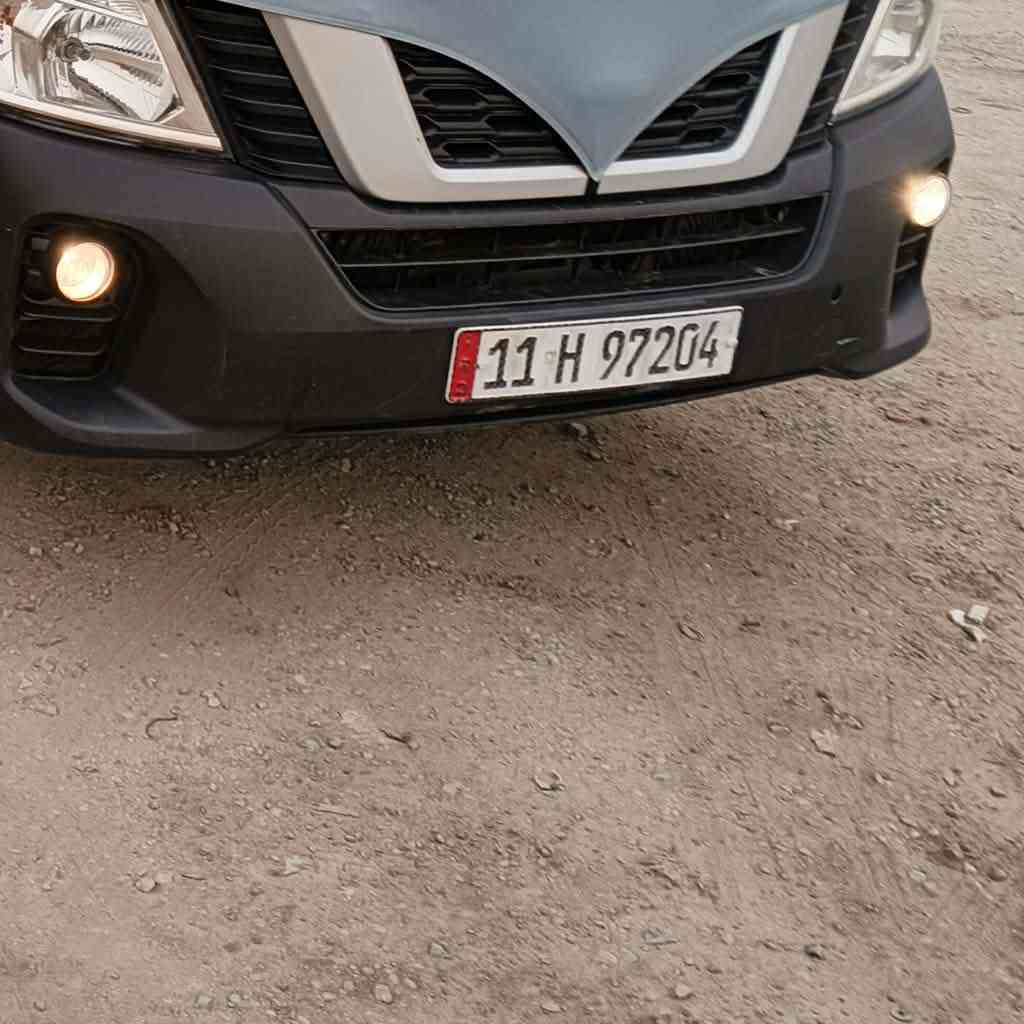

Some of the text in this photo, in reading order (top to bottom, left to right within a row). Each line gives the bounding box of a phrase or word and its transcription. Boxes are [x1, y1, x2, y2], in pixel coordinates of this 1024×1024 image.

[483, 337, 537, 389] 11
[555, 333, 586, 383] H
[600, 320, 720, 381] 97204
